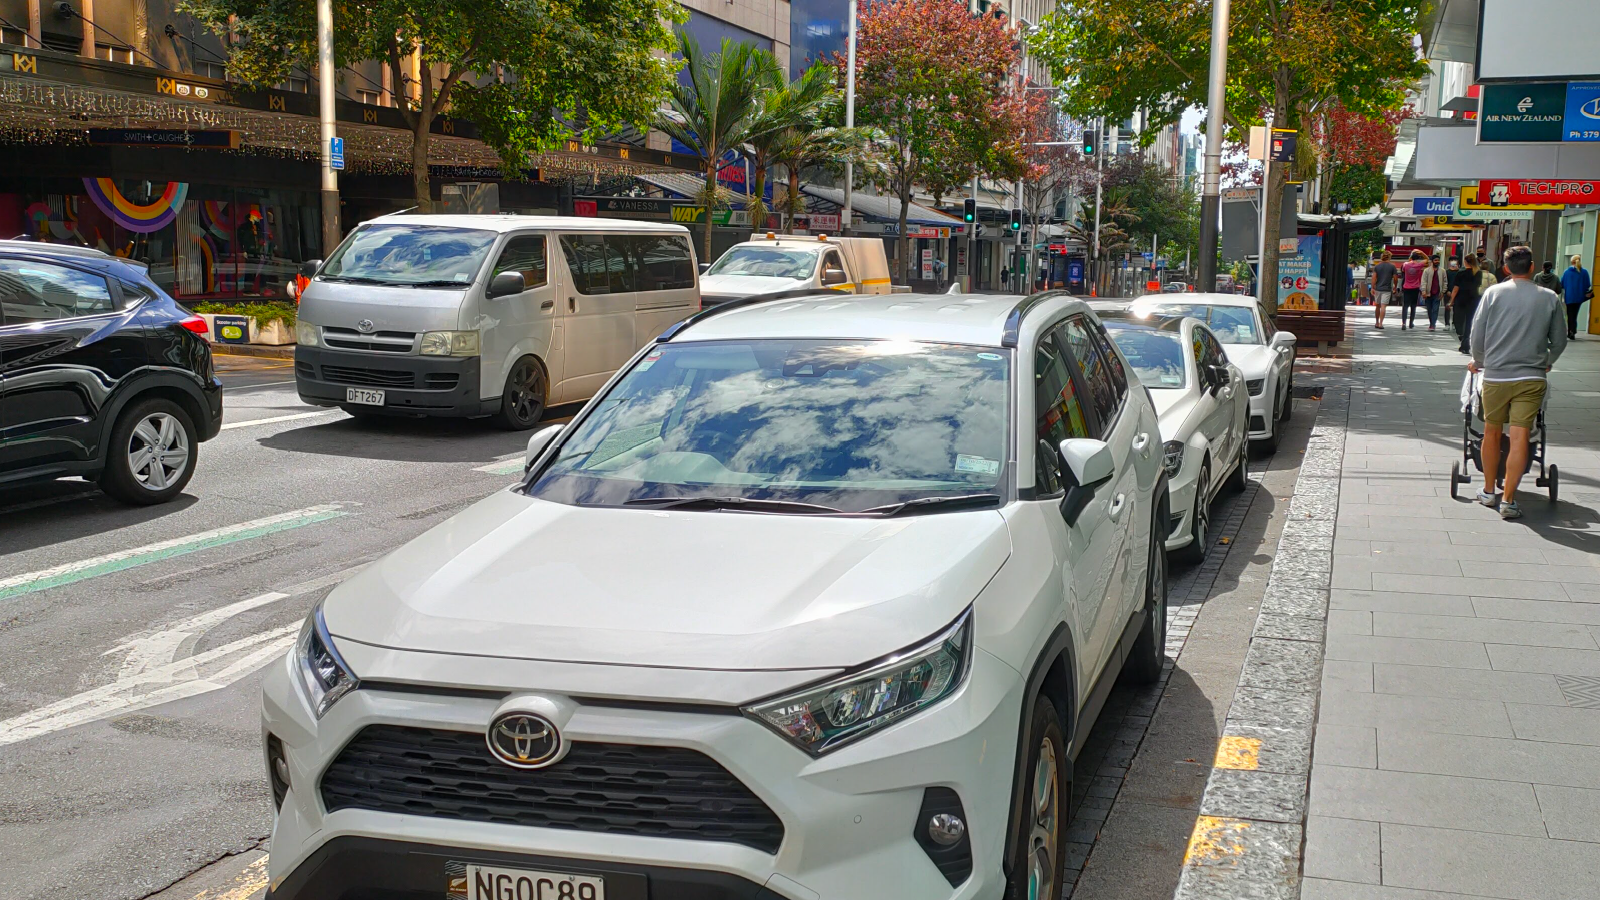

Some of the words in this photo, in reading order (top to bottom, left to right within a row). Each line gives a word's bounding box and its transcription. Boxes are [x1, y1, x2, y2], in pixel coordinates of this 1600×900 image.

[1485, 114, 1500, 122] AIR
[1501, 114, 1522, 122] NEW
[1521, 114, 1562, 122] ZEALAND
[620, 200, 659, 211] VANESSA
[224, 328, 230, 336] P
[348, 390, 383, 404] DFT267
